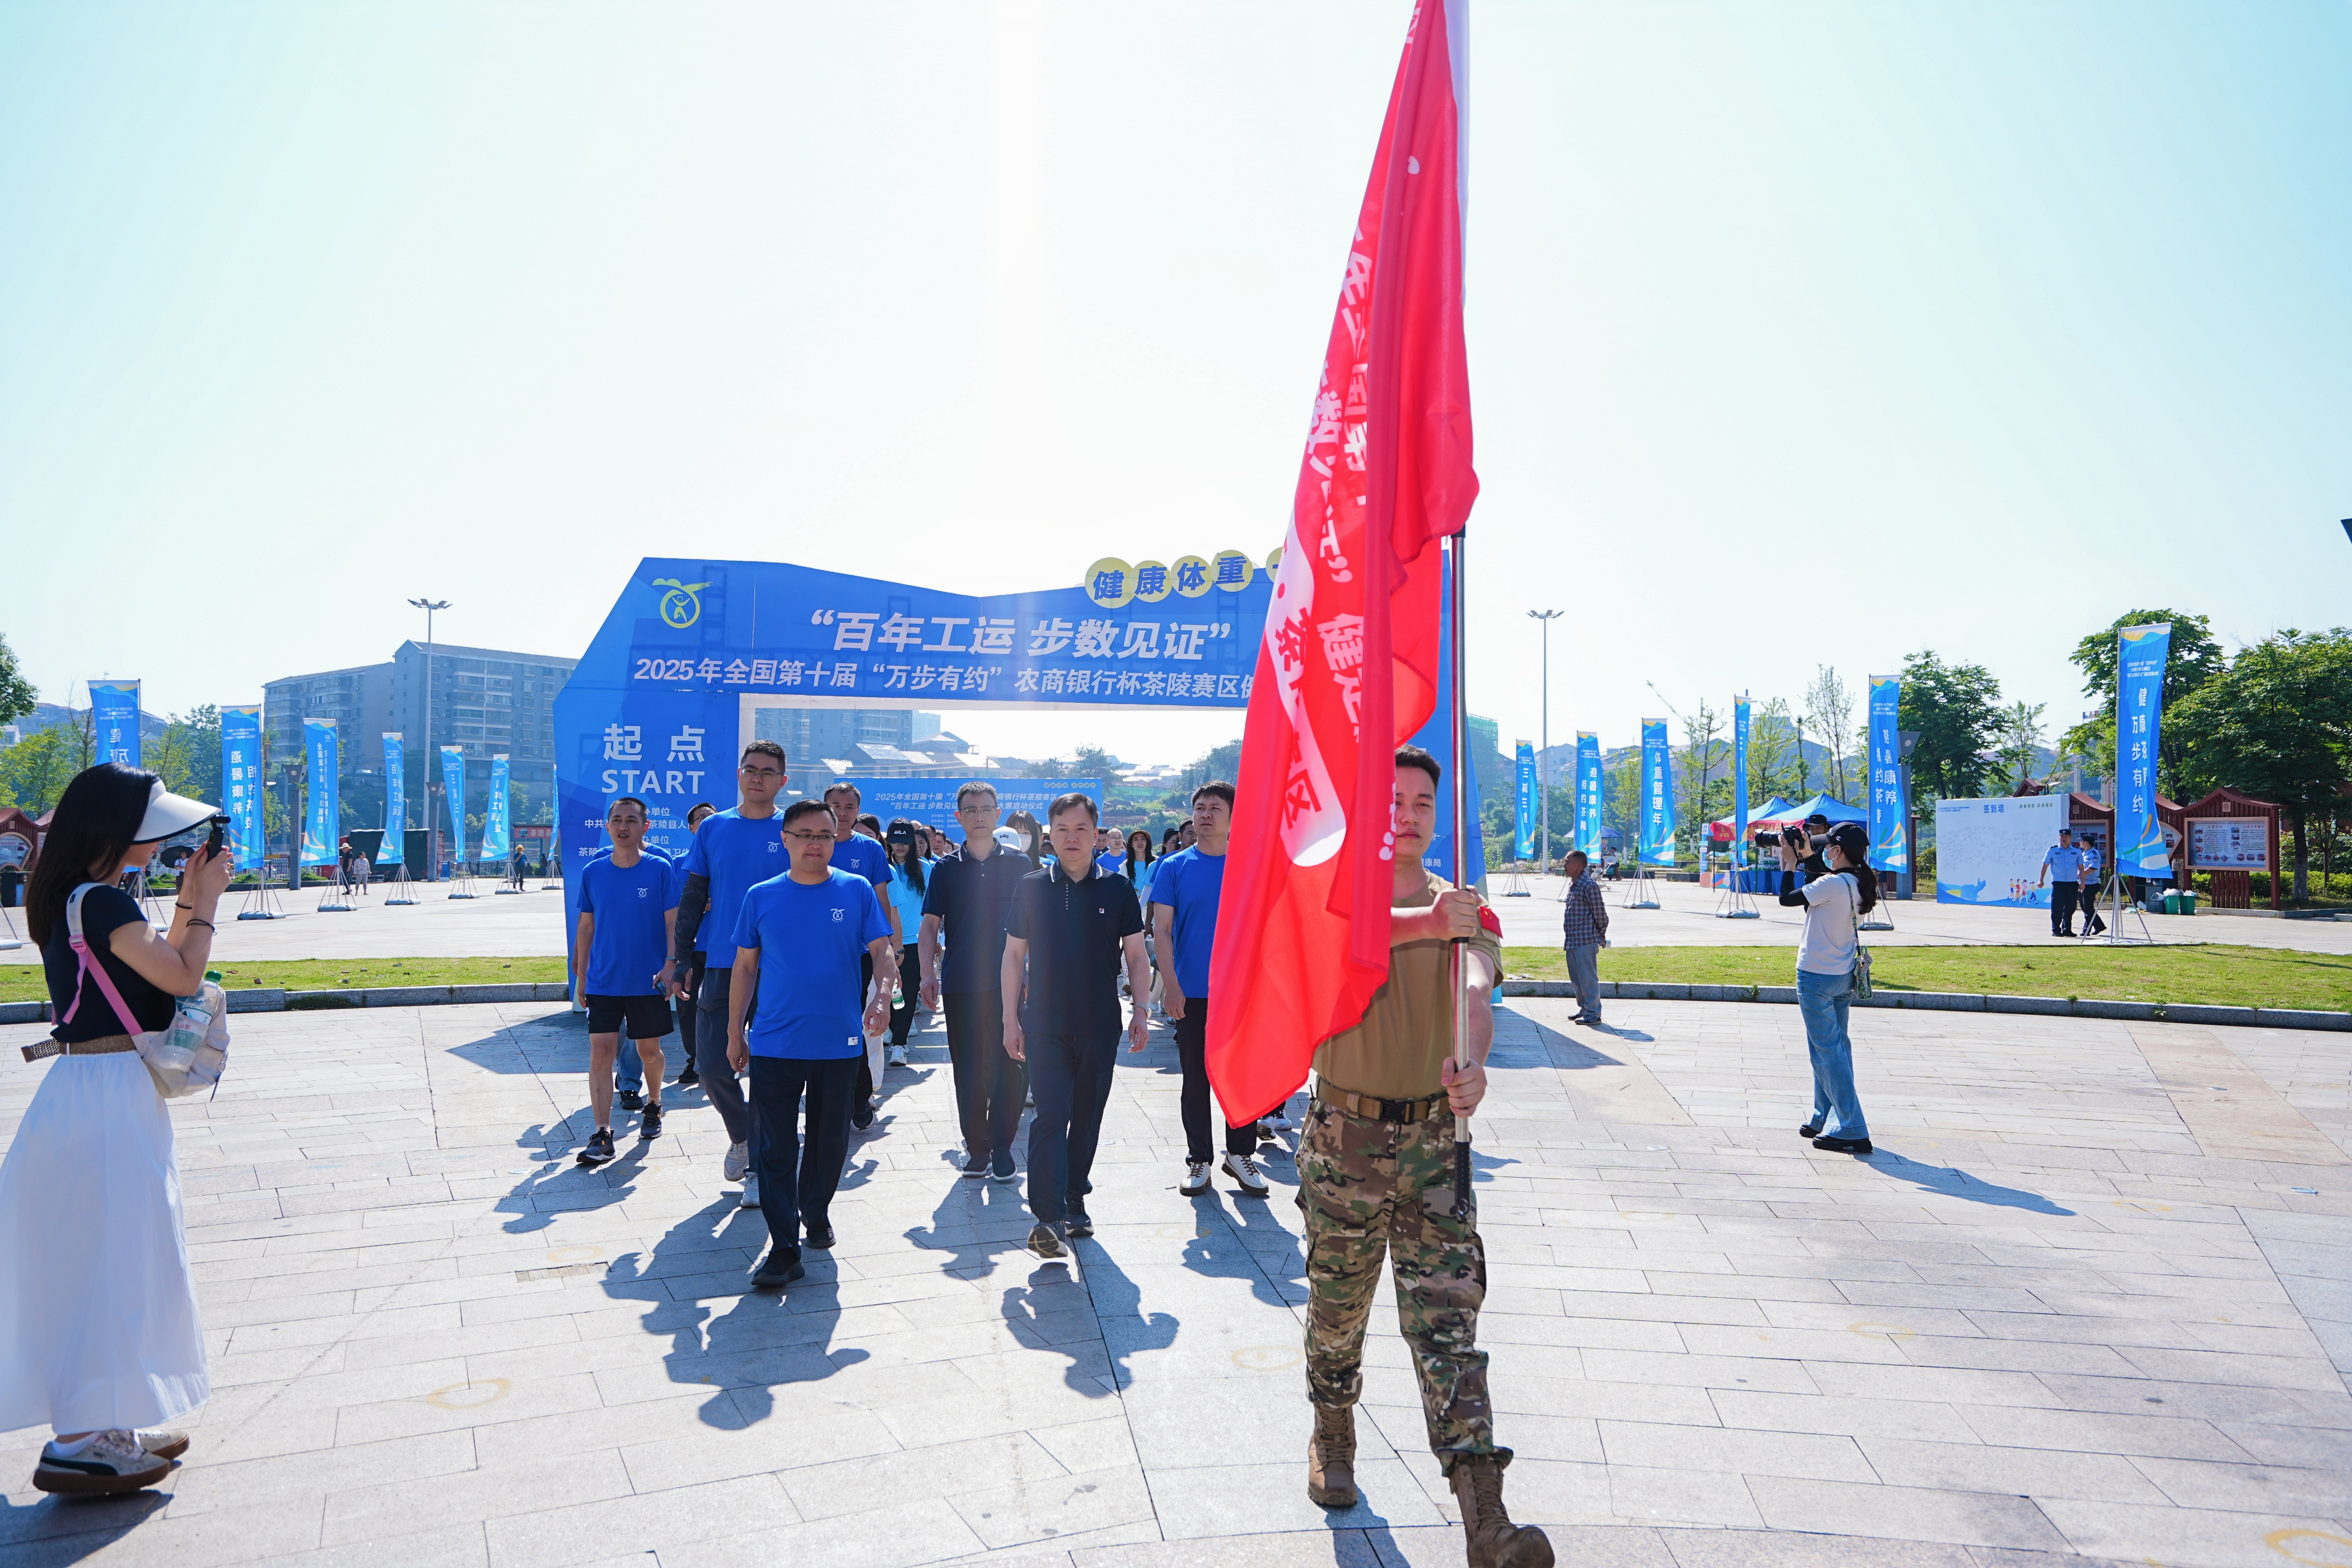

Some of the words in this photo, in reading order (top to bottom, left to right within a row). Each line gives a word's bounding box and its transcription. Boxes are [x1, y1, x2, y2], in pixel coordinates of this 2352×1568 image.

[1093, 556, 1247, 600] 健康体重
[1026, 617, 1231, 660] 步数见证”
[601, 769, 705, 794] START
[2131, 716, 2144, 814] 万步有约
[1589, 767, 1597, 819] 避暑康养
[1653, 751, 1663, 825] 体重管理年
[1984, 804, 2004, 813] 签到墙
[585, 819, 607, 829] 中共
[648, 820, 689, 829] 茶陵县人
